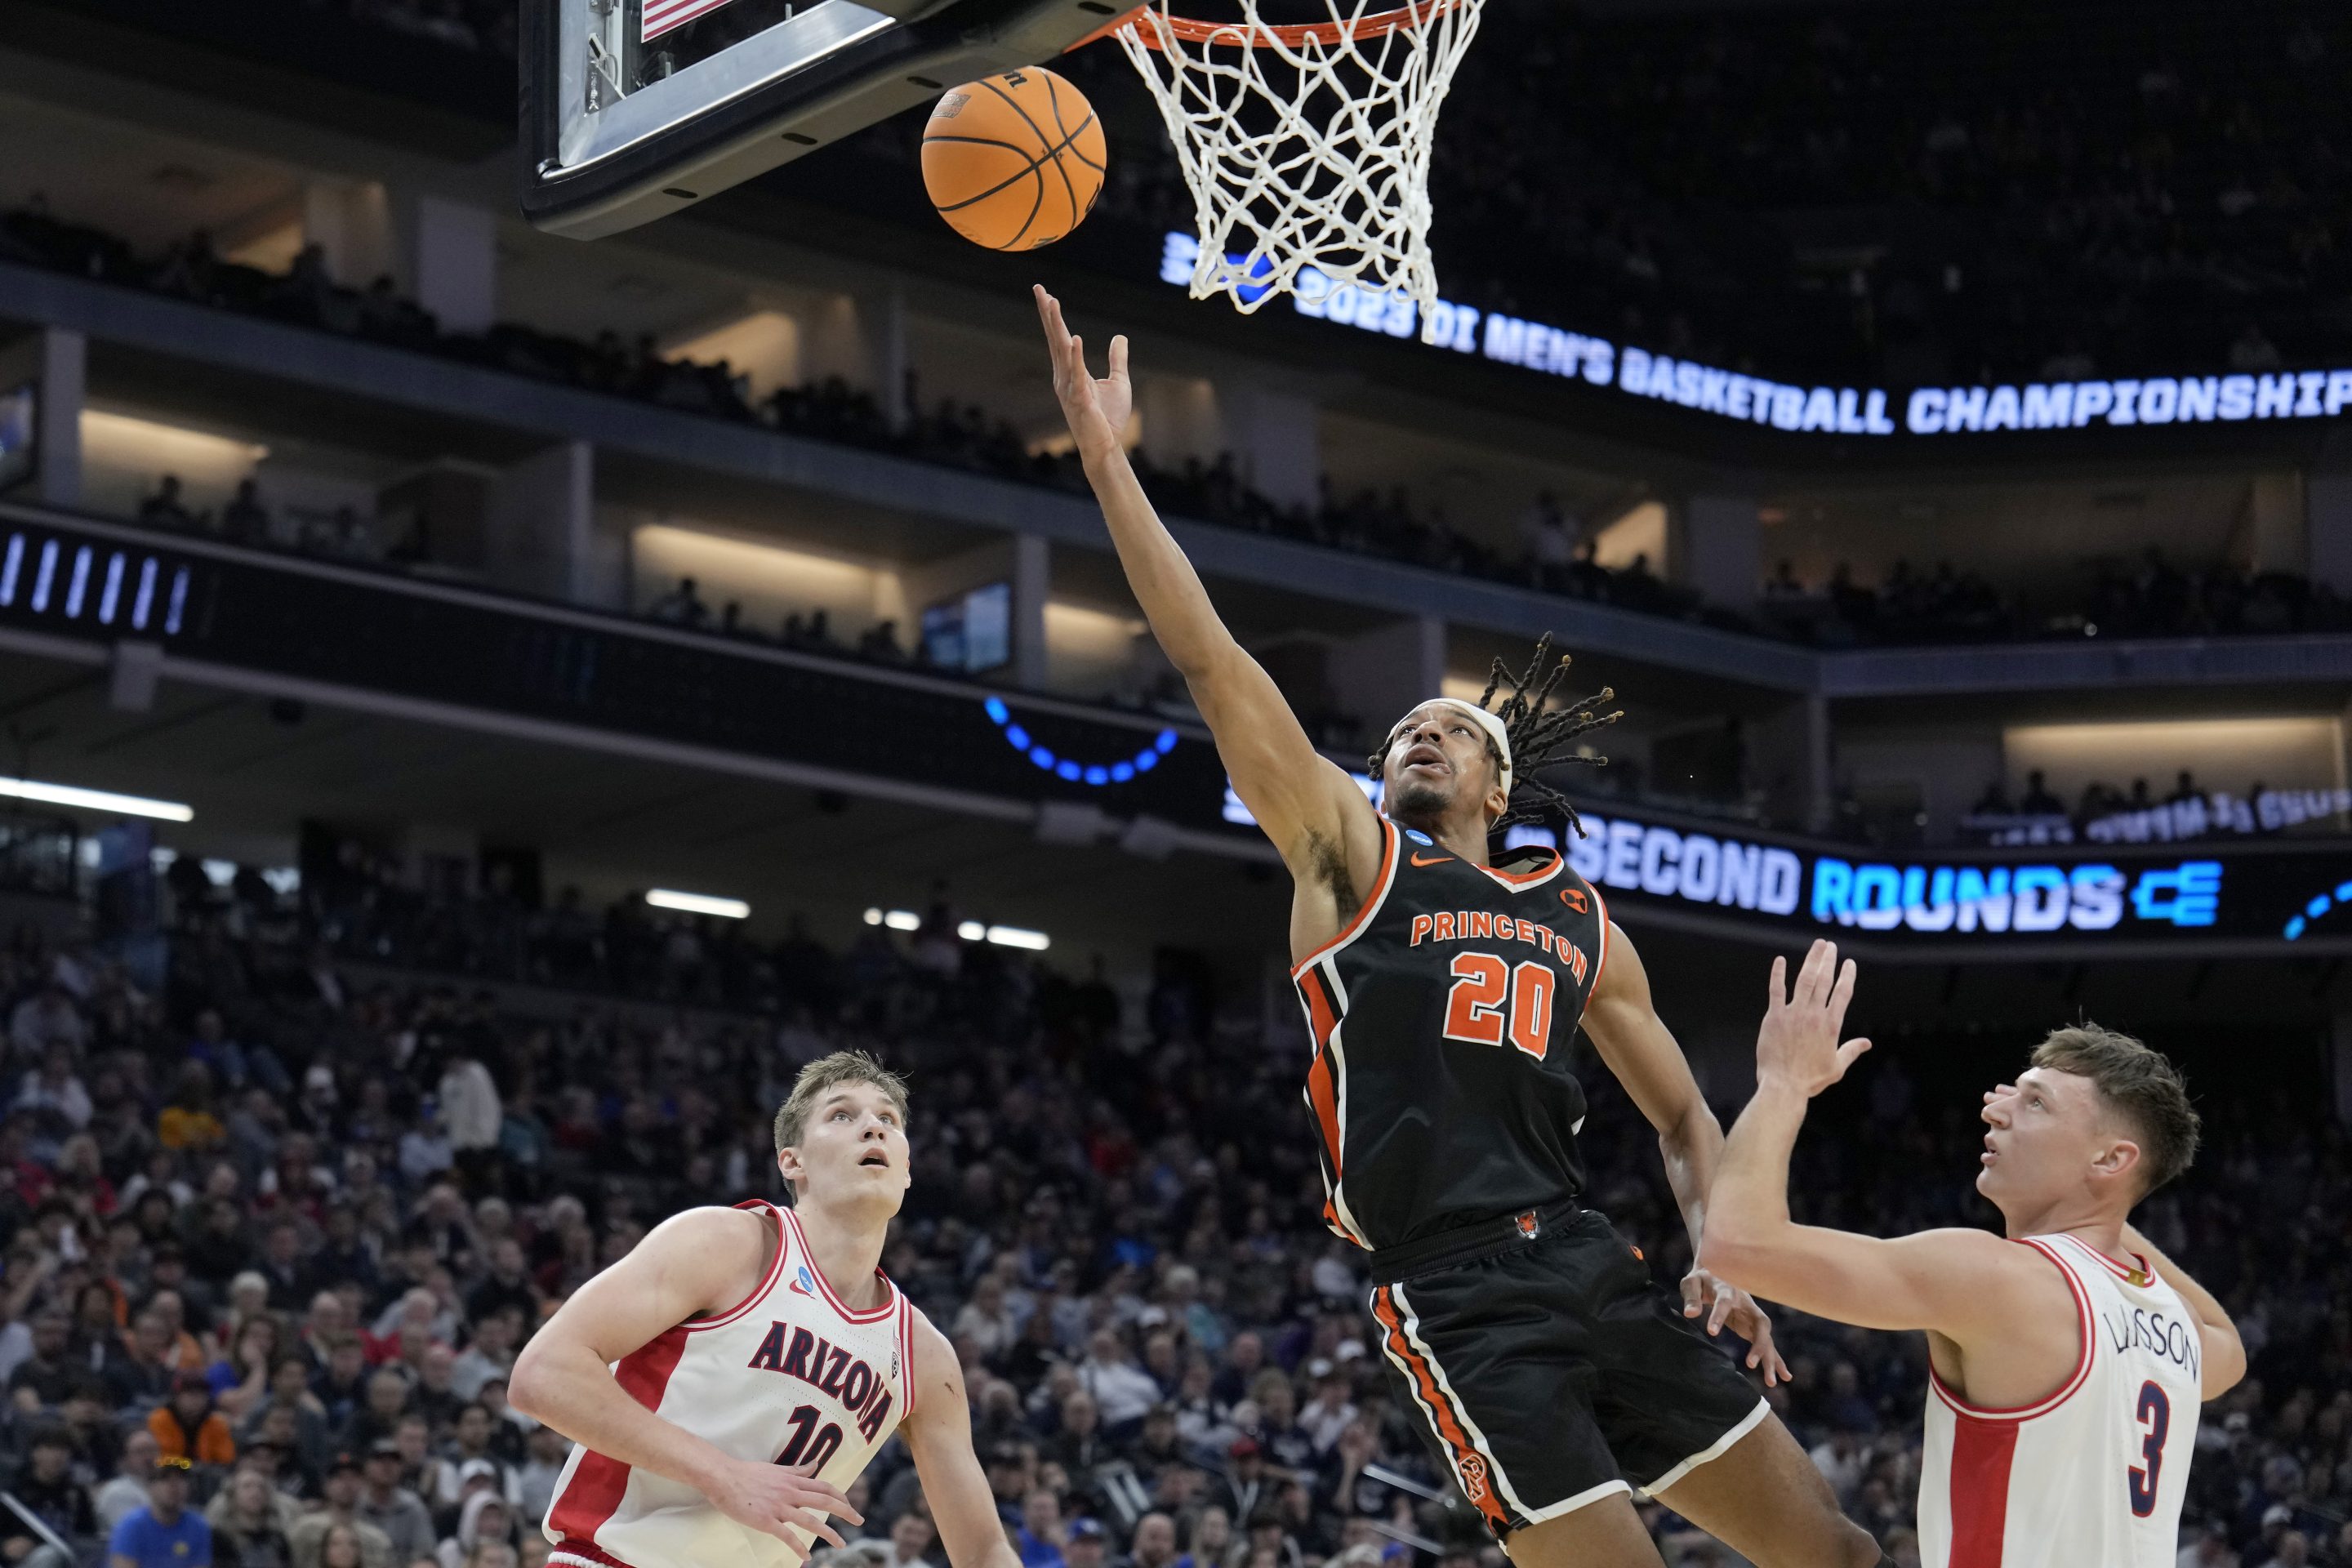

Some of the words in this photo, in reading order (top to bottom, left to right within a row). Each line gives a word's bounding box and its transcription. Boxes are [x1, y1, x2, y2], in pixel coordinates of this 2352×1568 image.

[1294, 265, 1418, 340] 2023
[1483, 313, 1615, 387] MEN'S
[1619, 347, 1895, 435] BASKETBALL
[1907, 369, 2352, 435] CHAMPIONSHIP
[1565, 813, 1802, 917] SECOND
[1810, 856, 2126, 933] ROUNDS
[1410, 911, 1588, 987] PRINCETON
[1442, 951, 1555, 1062] 20
[747, 1320, 893, 1446] ARIZONA
[773, 1404, 844, 1480] 10
[2128, 1379, 2170, 1517] 3
